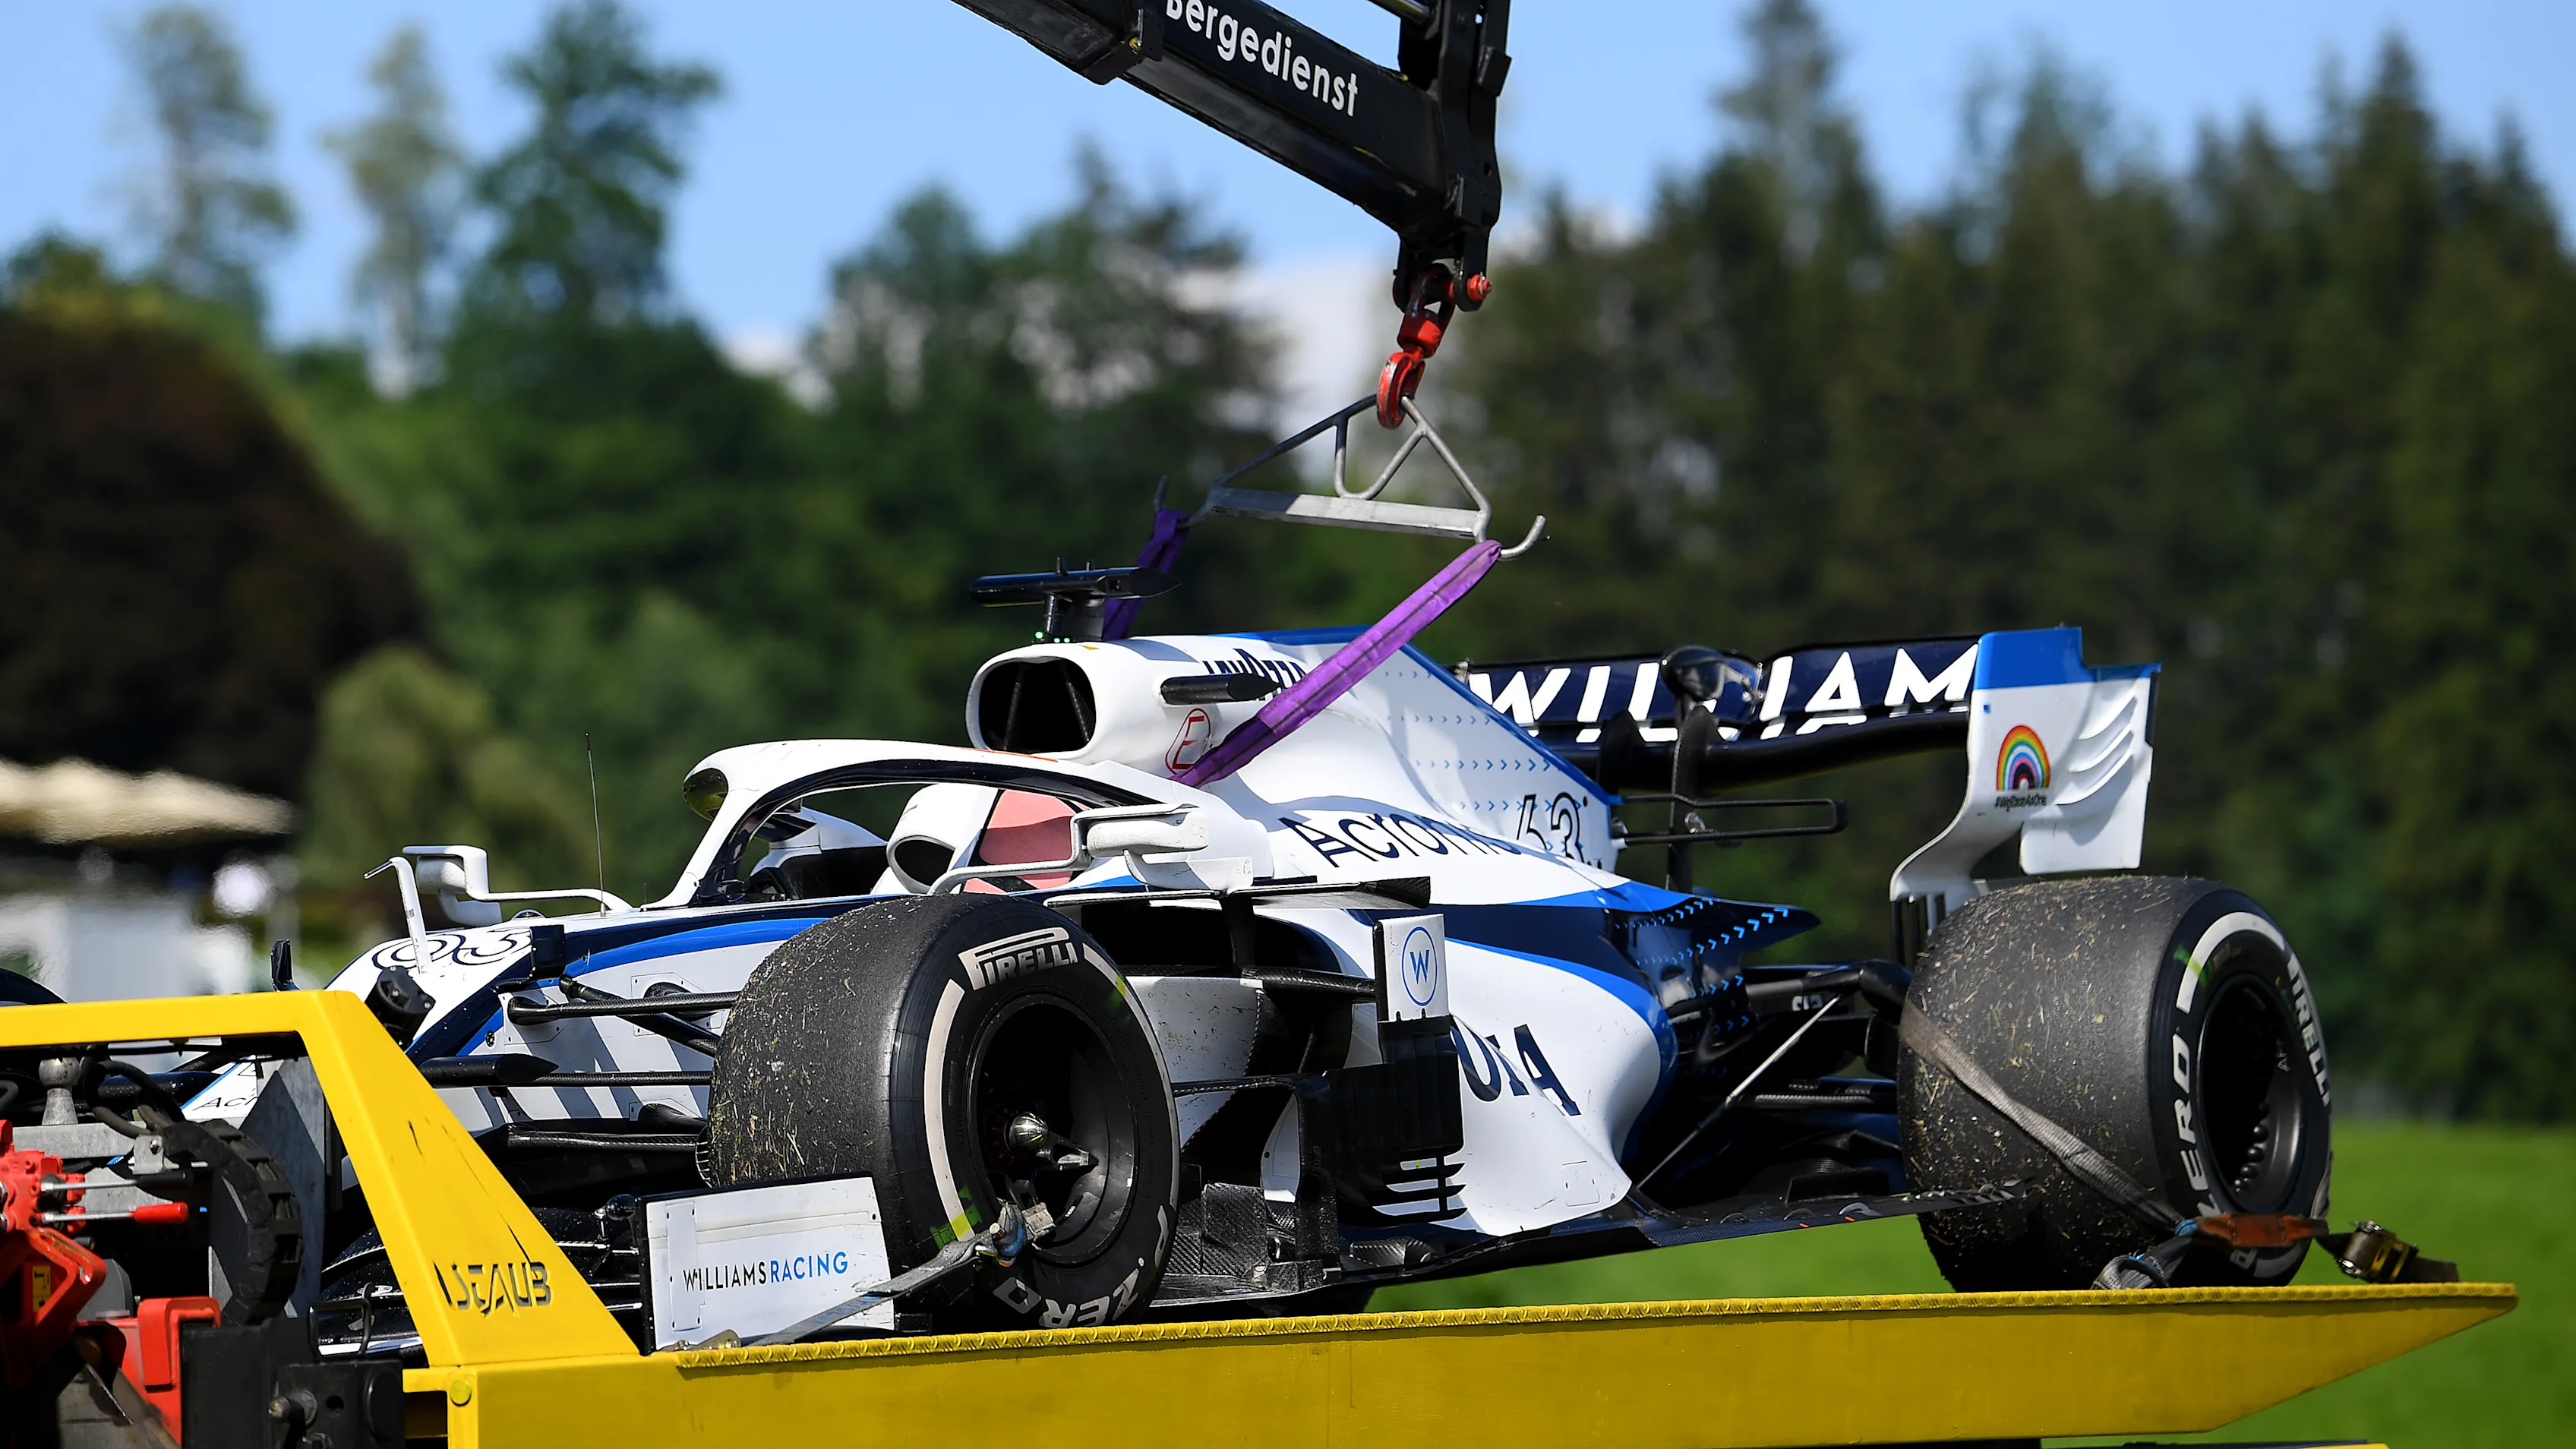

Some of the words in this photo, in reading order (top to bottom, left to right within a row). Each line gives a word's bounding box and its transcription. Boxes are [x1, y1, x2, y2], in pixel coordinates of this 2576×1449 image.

[1469, 643, 1979, 744] WILIAM
[958, 927, 1078, 991] PIRELLI
[992, 1267, 1140, 1329] ZERO
